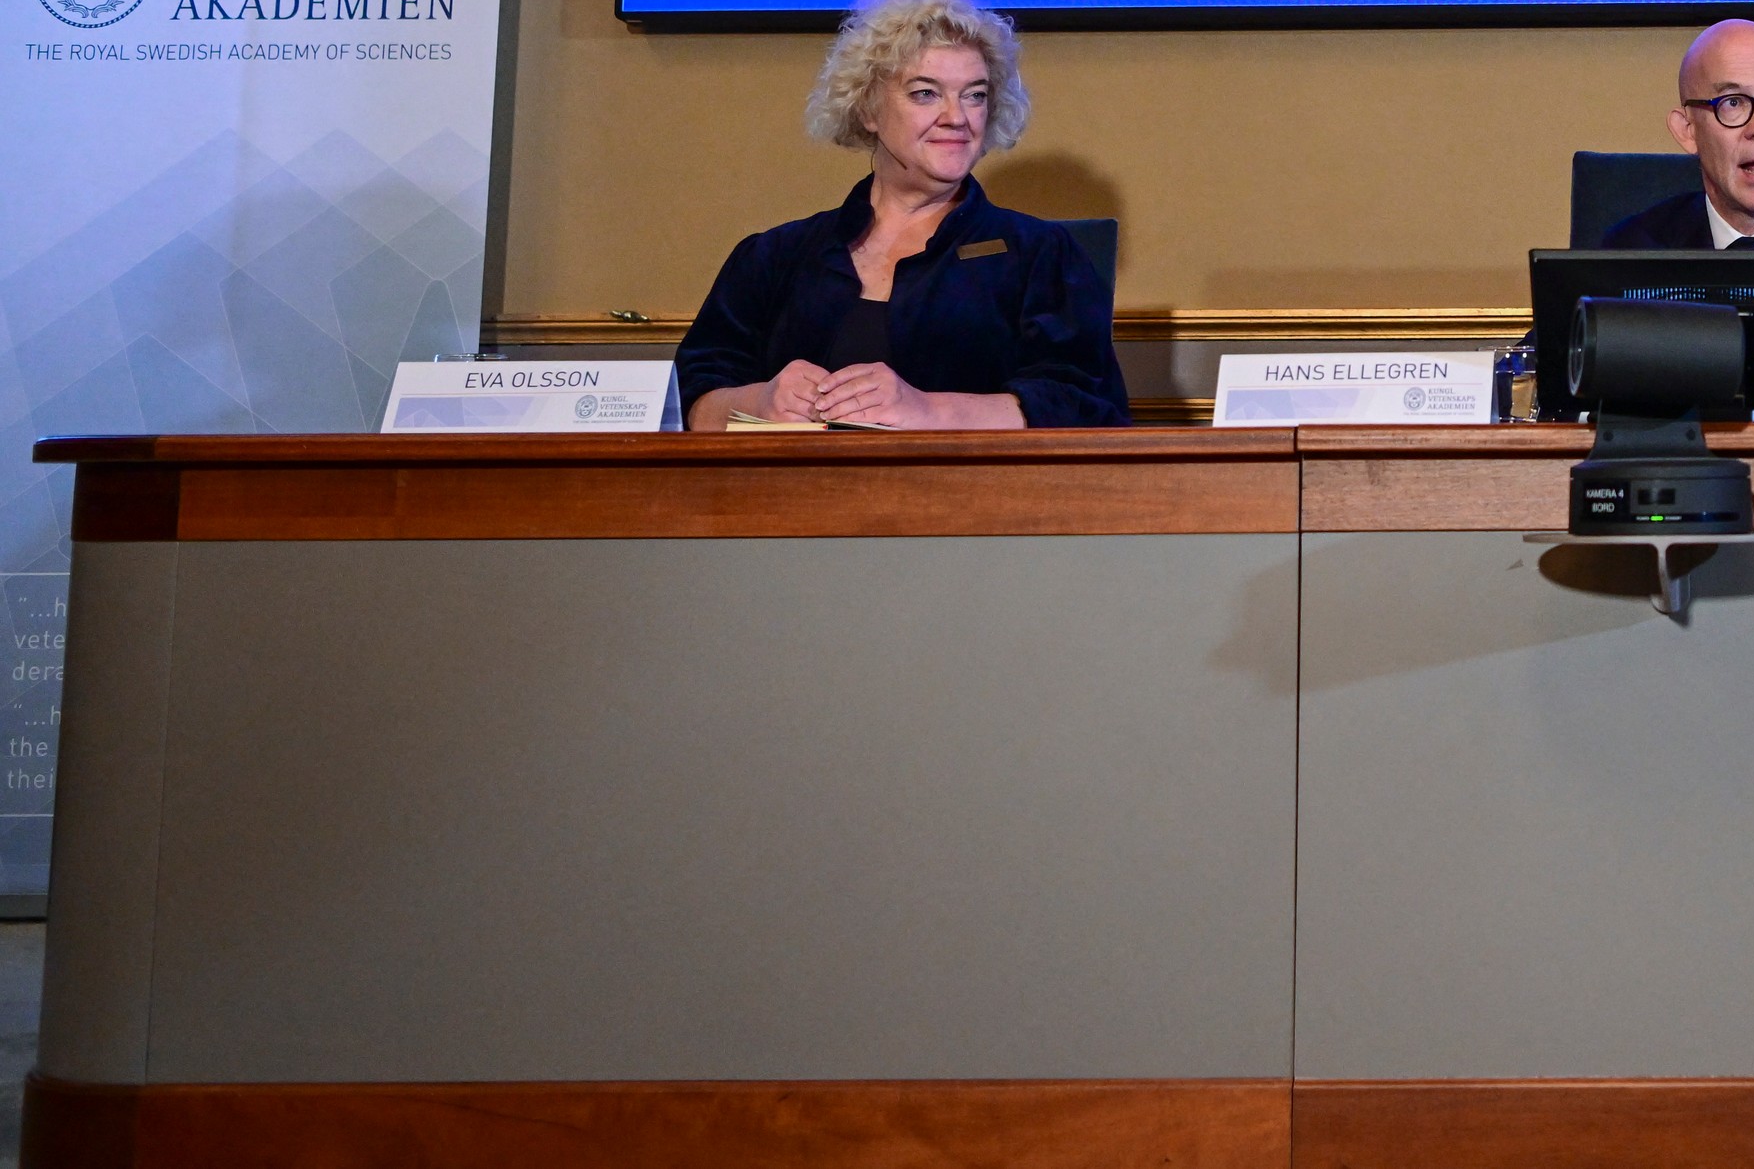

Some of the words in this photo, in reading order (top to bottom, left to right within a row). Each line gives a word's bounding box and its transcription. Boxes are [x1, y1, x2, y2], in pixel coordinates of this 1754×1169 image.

[25, 44, 63, 60] THE
[70, 44, 130, 61] ROYAL
[136, 44, 222, 60] SWEDISH
[228, 44, 320, 60] ACADEMY
[326, 44, 349, 60] OF
[356, 44, 452, 60] SCIENCES
[465, 372, 504, 388] EVA
[512, 371, 599, 388] OLSSON
[1265, 365, 1325, 381] HANS
[1333, 363, 1449, 380] ELLEGREN
[1586, 489, 1616, 498] KAMERA
[1618, 489, 1624, 498] 4
[1592, 503, 1614, 513] BORD
[14, 631, 65, 649] vete
[12, 661, 64, 681] dera
[9, 737, 48, 757] the
[7, 767, 55, 789] thei
